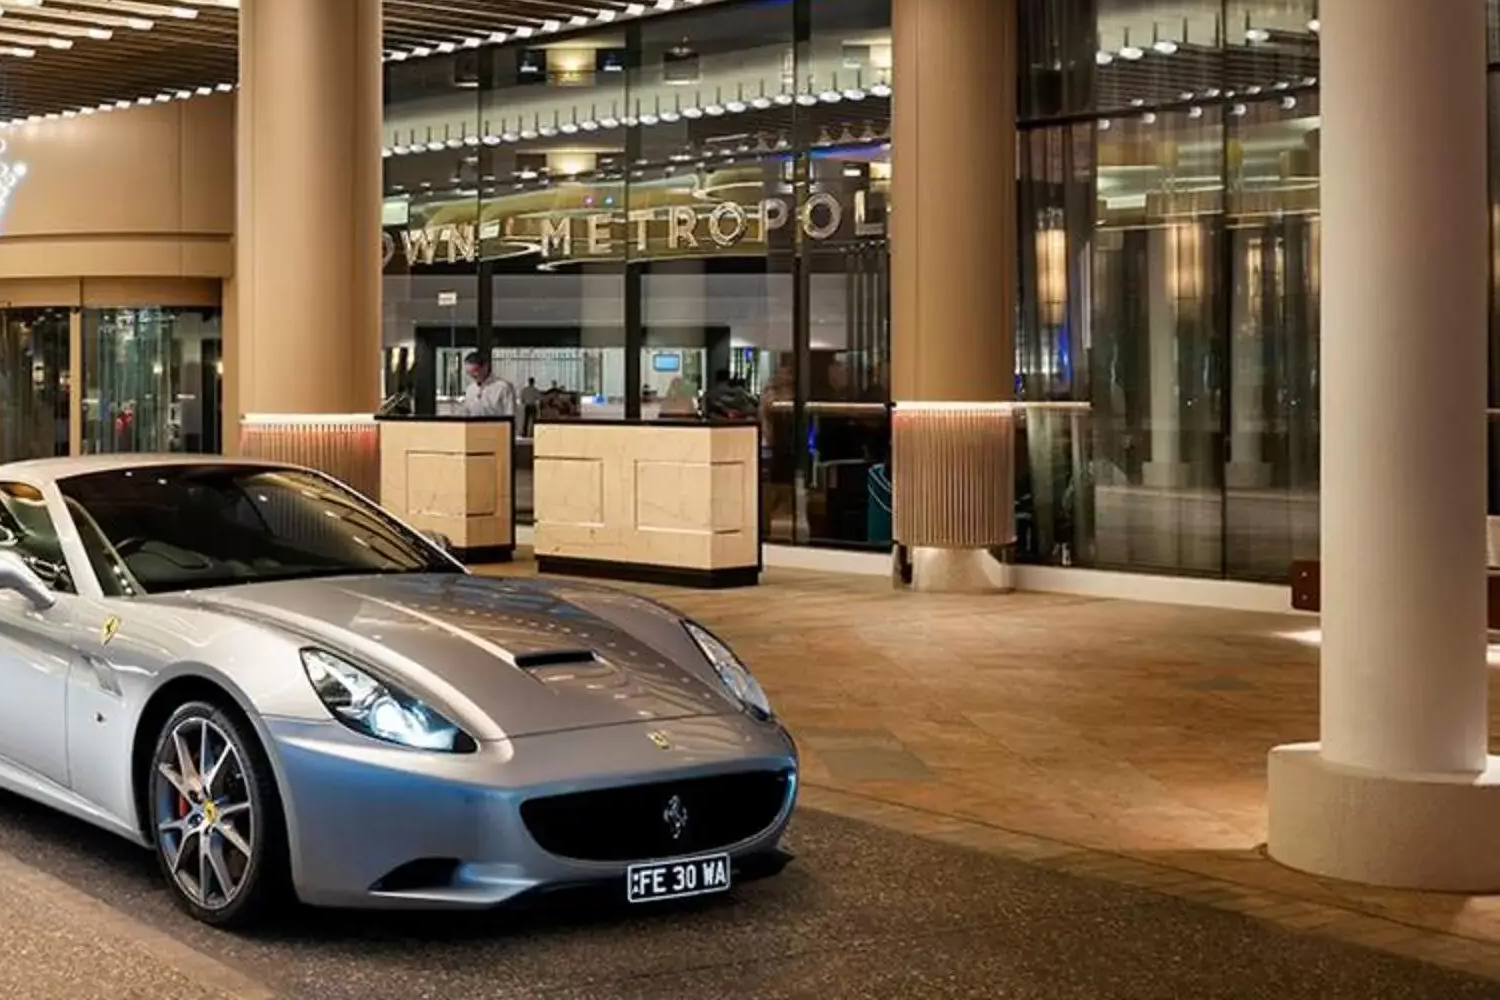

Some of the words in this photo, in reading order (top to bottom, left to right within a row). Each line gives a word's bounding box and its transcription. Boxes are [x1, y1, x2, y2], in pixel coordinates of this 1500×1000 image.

[541, 193, 884, 257] METROPOL
[639, 868, 667, 895] FE
[672, 864, 697, 891] 30
[701, 860, 727, 886] WA
